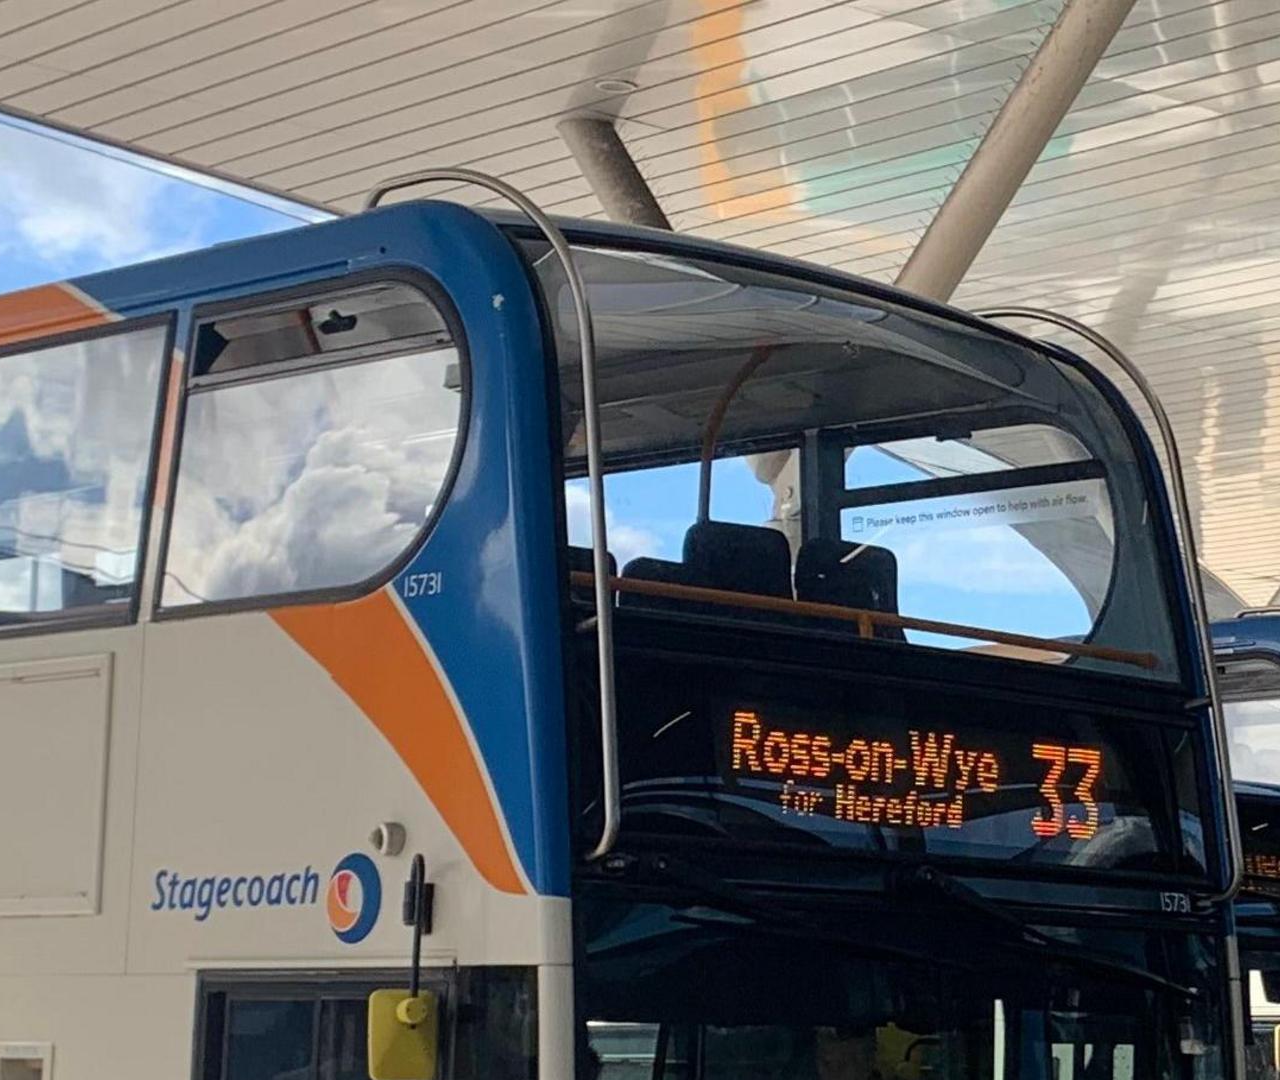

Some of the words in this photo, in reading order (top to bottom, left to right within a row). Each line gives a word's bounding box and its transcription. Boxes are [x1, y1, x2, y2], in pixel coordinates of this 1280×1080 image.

[896, 514, 917, 526] keep
[918, 512, 934, 522] this
[936, 508, 970, 520] window
[972, 506, 996, 517] open
[997, 504, 1007, 513] to
[1008, 501, 1028, 513] help
[1029, 498, 1050, 509] with
[404, 572, 443, 598] 15731
[731, 710, 1000, 793] Ross-on-Wye
[780, 779, 823, 817] for
[835, 784, 964, 829] Hereford
[1031, 743, 1102, 840] 33
[151, 865, 320, 922] Stagecoach
